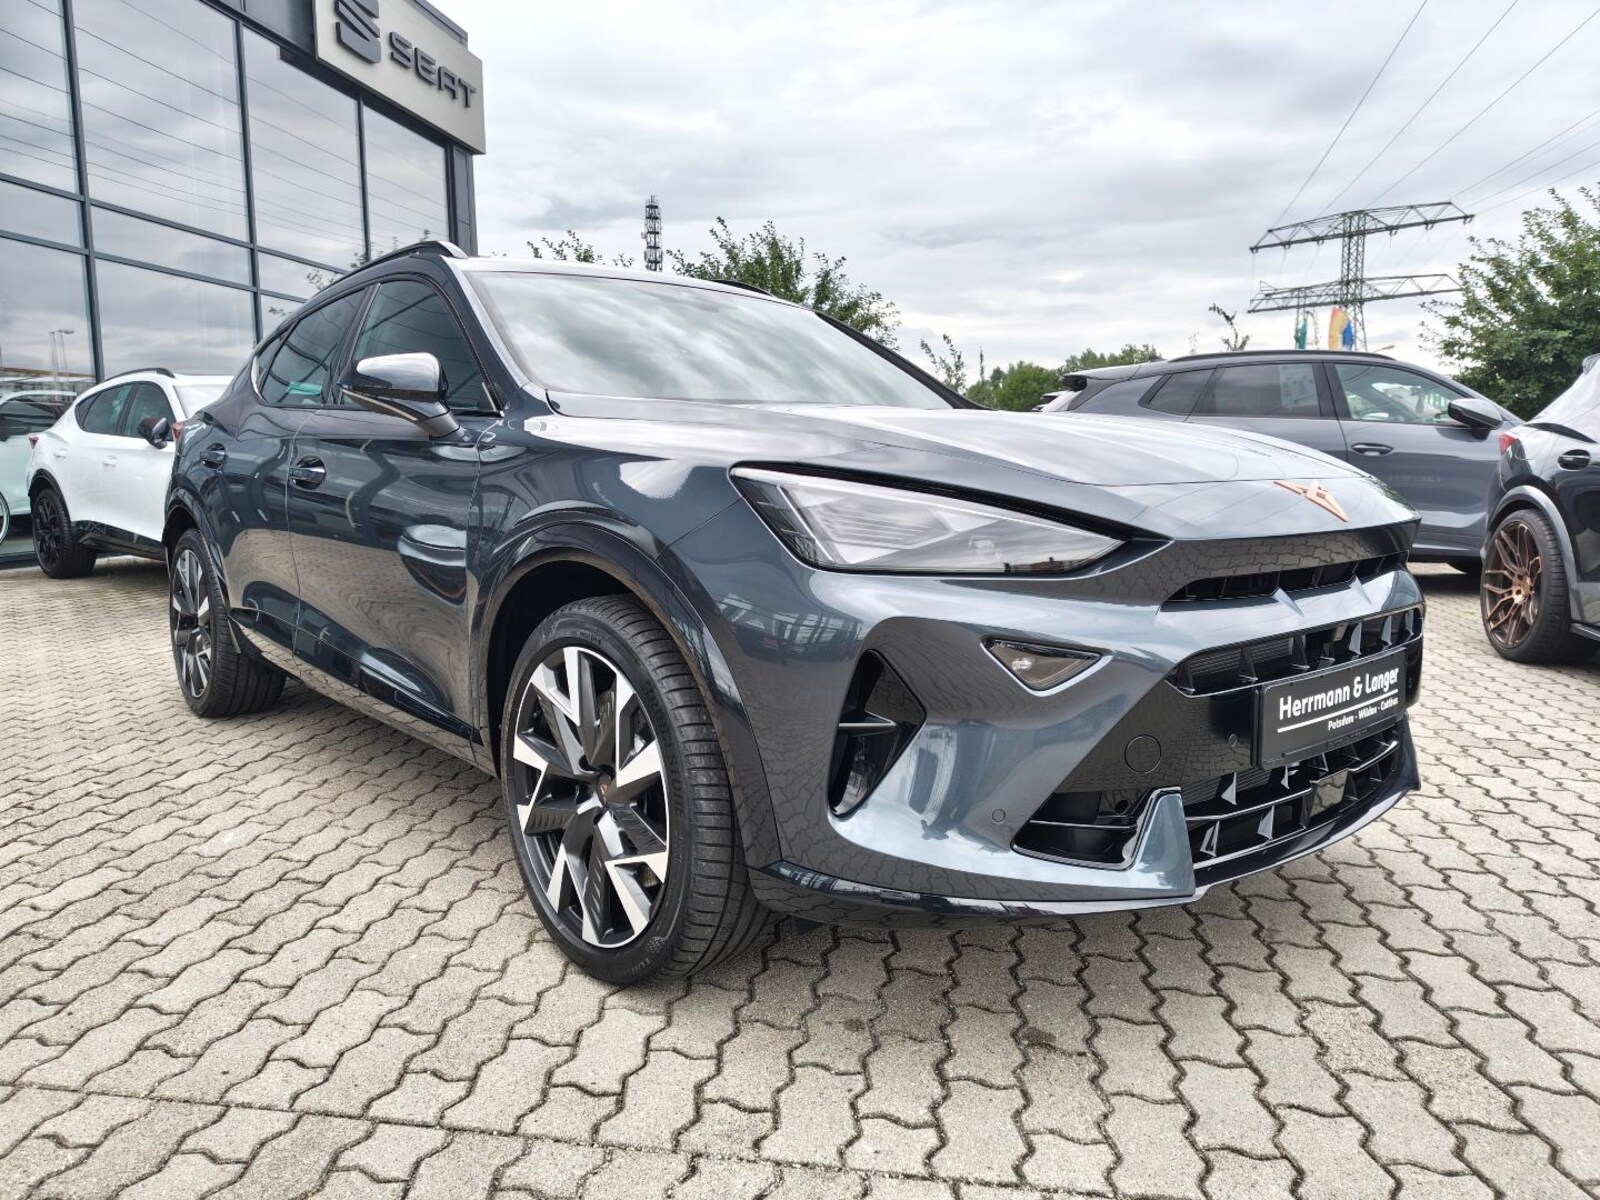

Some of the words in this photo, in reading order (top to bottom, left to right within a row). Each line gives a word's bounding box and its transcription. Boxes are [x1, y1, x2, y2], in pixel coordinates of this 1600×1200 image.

[389, 31, 477, 108] SEAT
[1279, 685, 1350, 720] Herrmann
[1353, 676, 1363, 698] &
[1365, 668, 1399, 693] Langer
[1328, 715, 1354, 730] Potsdam
[1358, 705, 1377, 720] Wildau
